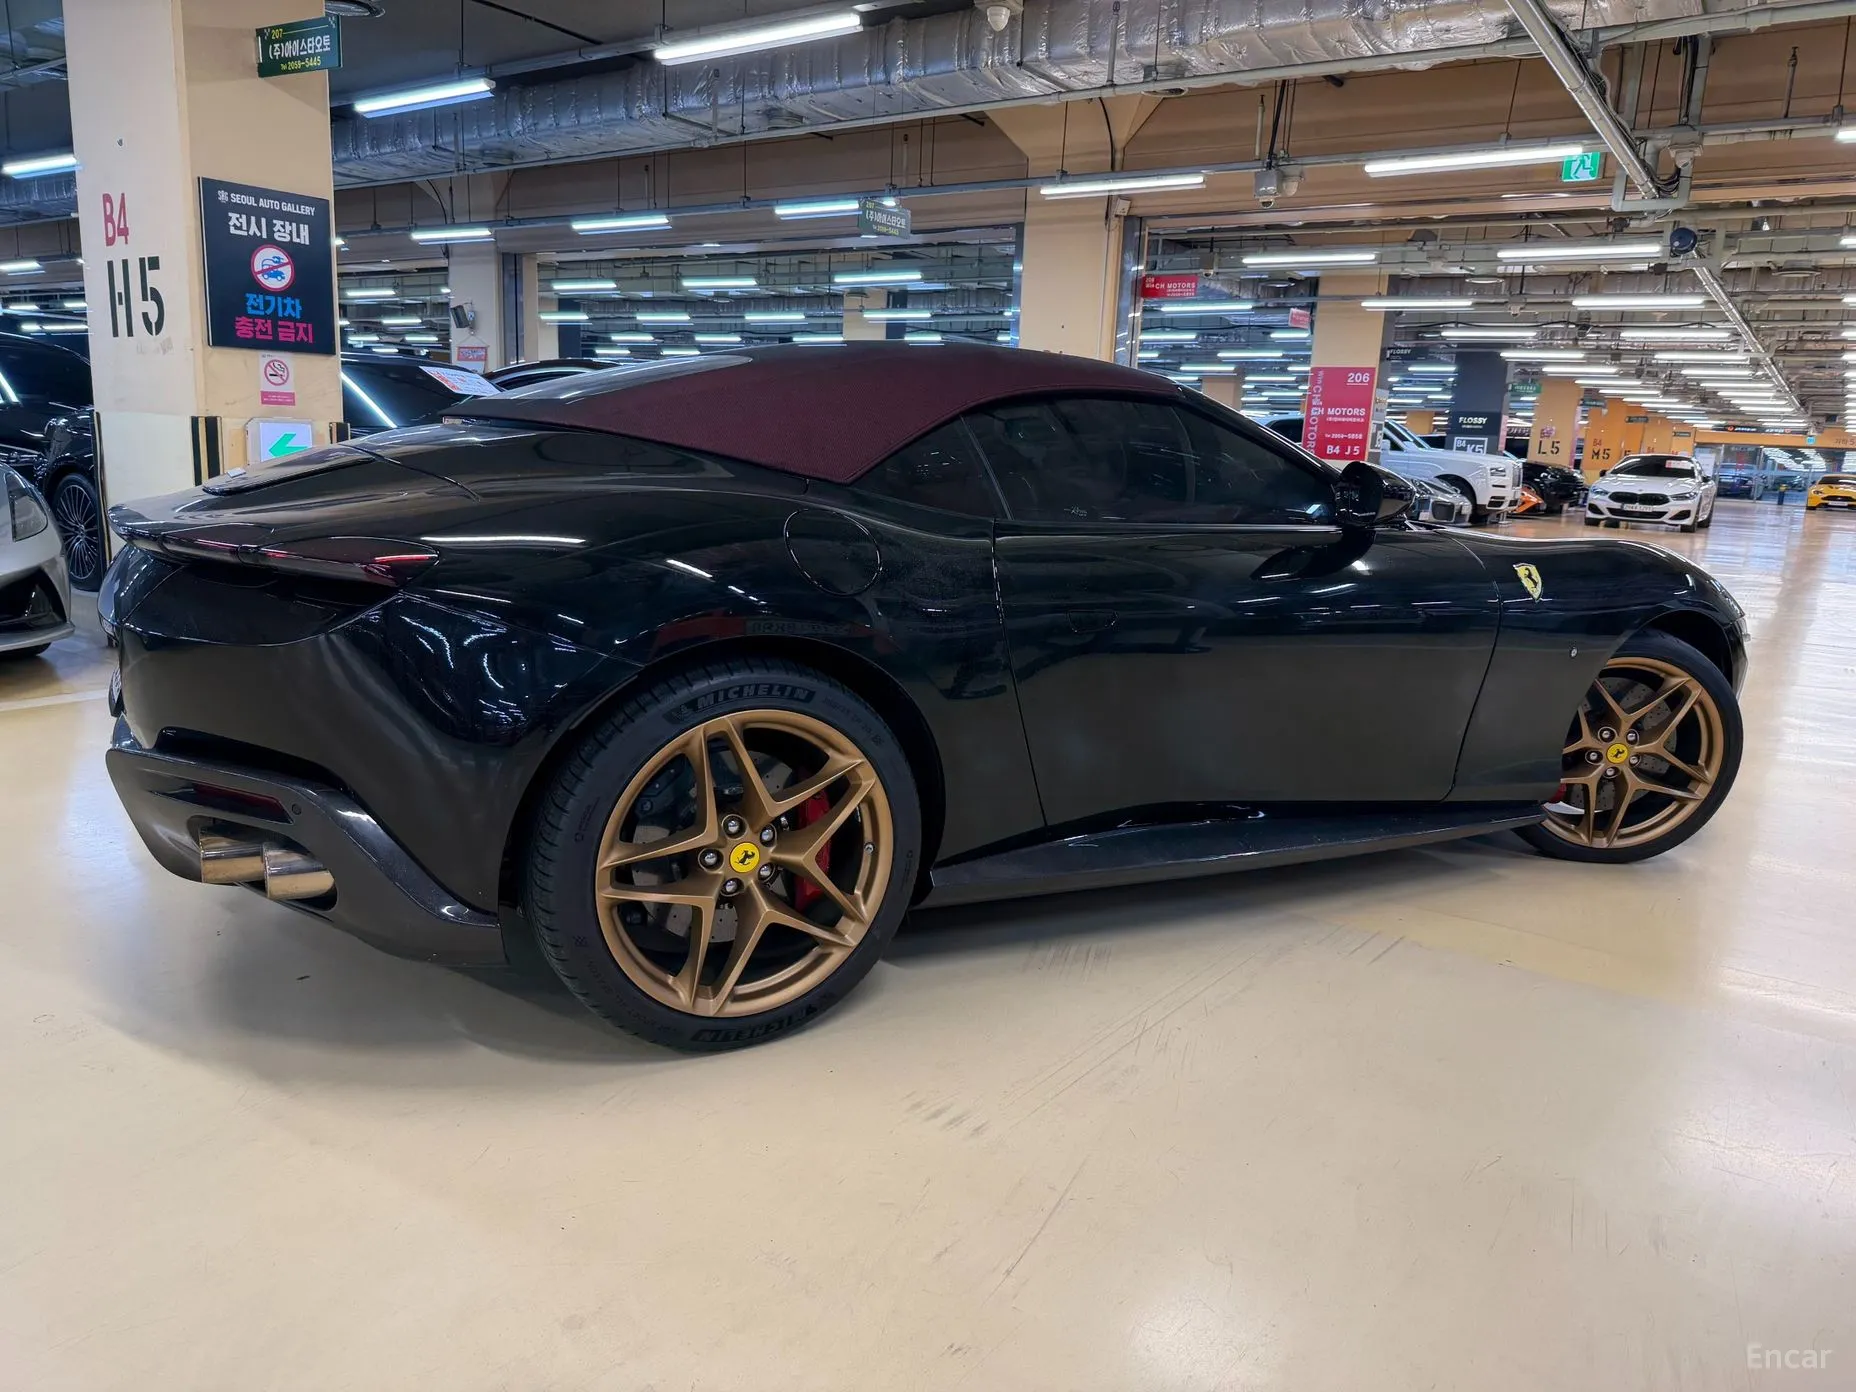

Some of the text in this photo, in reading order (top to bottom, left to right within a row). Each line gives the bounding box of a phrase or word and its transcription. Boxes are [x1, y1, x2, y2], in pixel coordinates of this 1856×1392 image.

[271, 28, 283, 39] 207
[230, 193, 257, 207] SEOUL
[258, 198, 280, 210] AUTO
[281, 202, 316, 216] GALLERY
[102, 192, 129, 247] B4
[228, 212, 310, 245] 전시 장내
[245, 293, 302, 319] 전기차
[235, 316, 314, 343] 충전 금지
[1347, 372, 1370, 383] 206
[1327, 408, 1366, 416] MOTORS
[1326, 445, 1340, 455] B4
[1466, 444, 1484, 455] K5
[697, 685, 809, 709] MICHELIN
